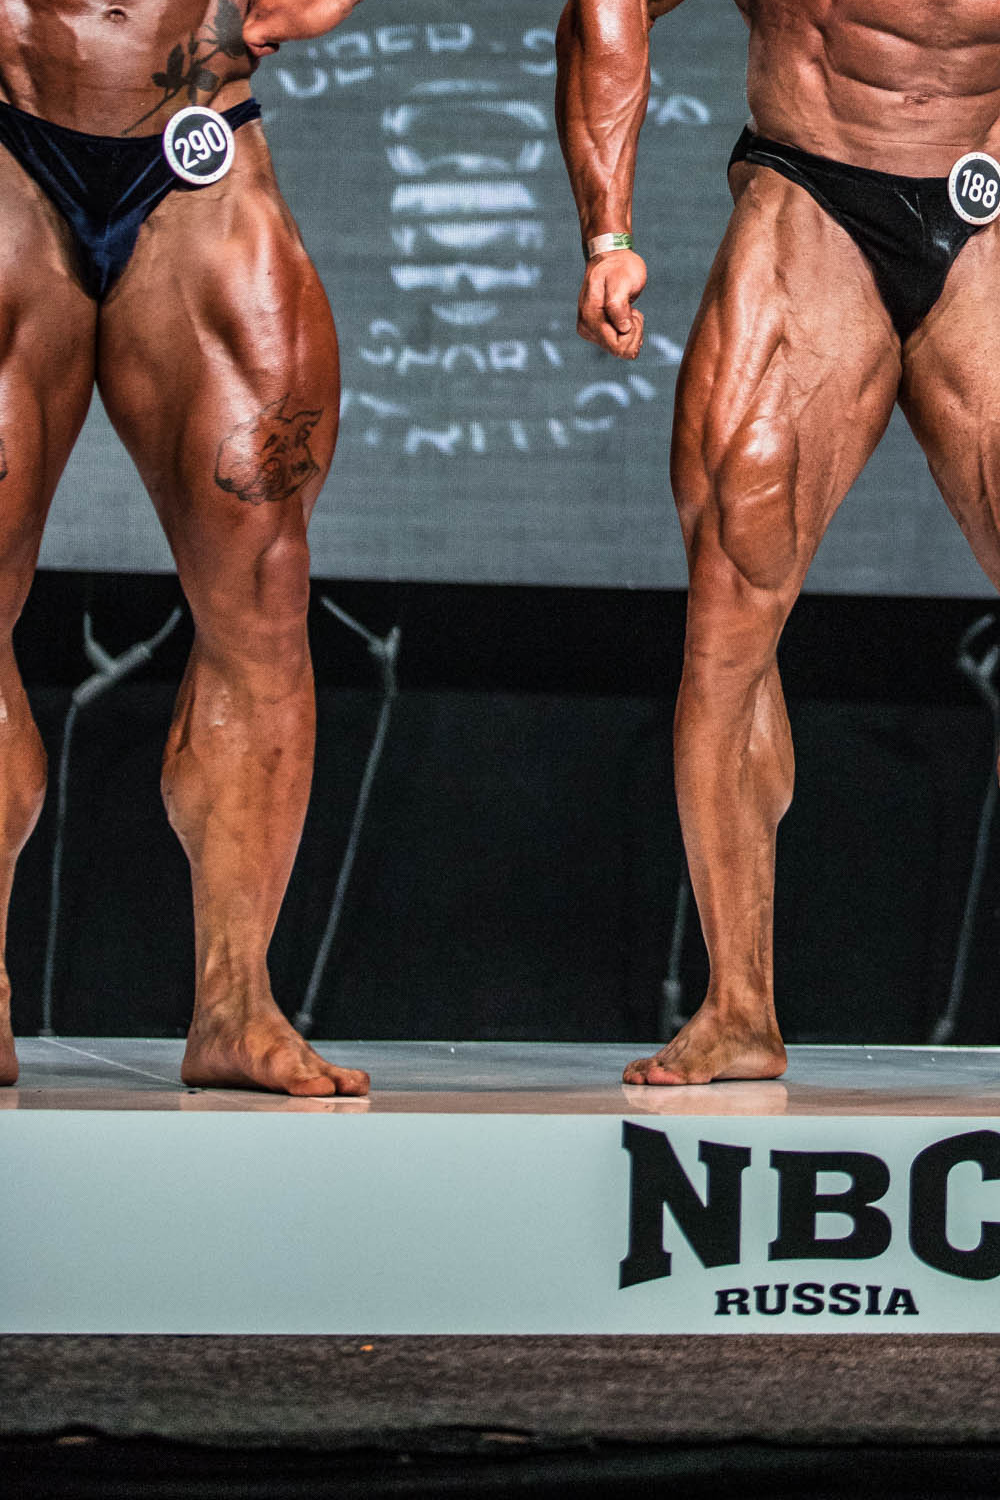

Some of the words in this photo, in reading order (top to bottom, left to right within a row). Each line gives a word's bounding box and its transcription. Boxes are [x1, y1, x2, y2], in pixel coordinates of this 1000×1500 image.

[175, 121, 226, 169] 290
[961, 169, 998, 208] 188
[714, 1282, 919, 1316] RUSSIA
